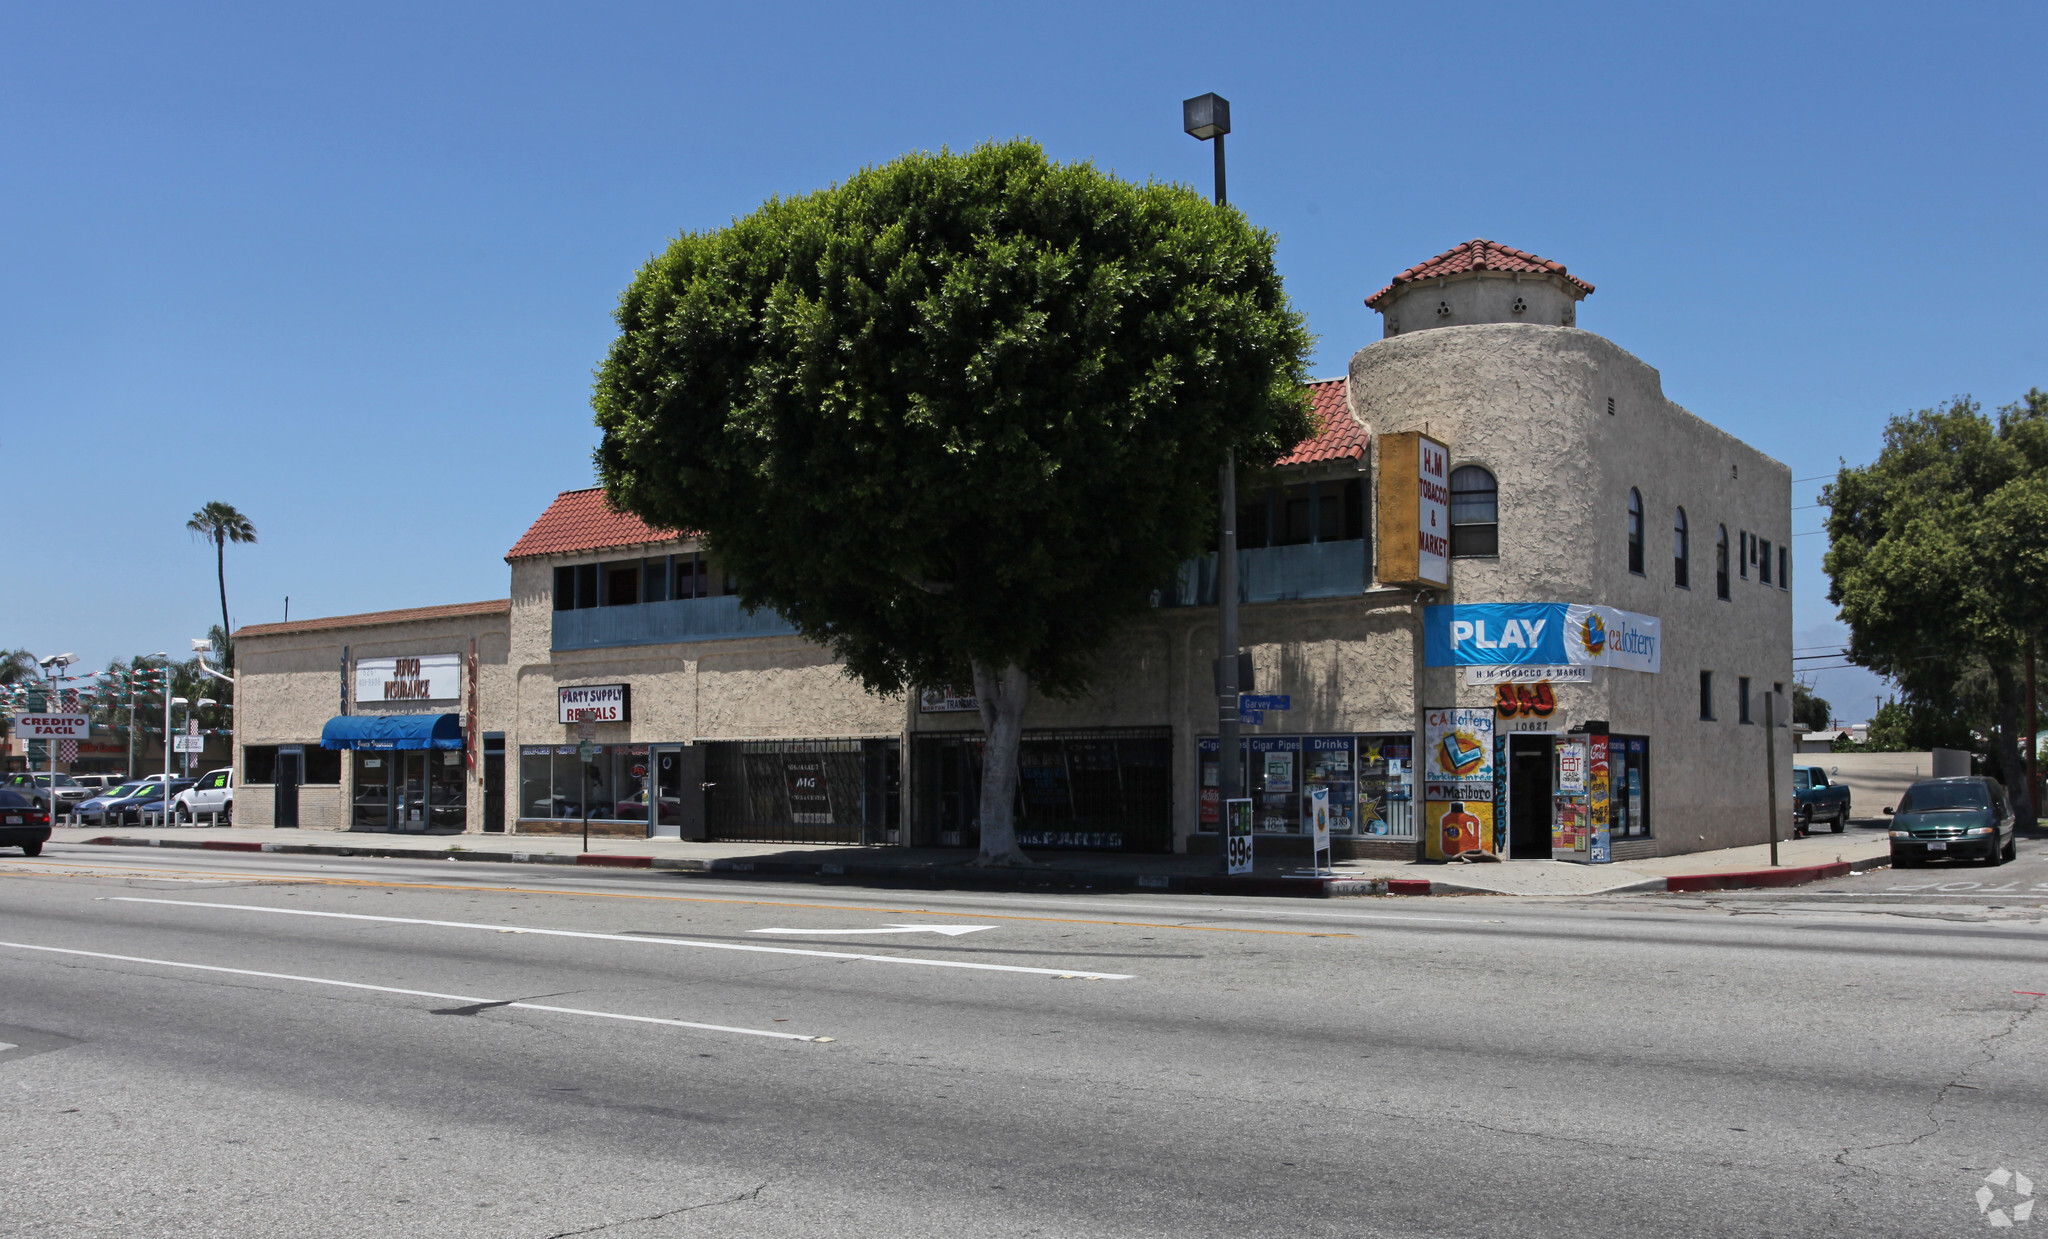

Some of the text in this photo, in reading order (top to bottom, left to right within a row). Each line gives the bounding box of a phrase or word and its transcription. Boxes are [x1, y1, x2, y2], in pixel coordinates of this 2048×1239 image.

[1424, 448, 1442, 478] H.M
[1420, 478, 1447, 506] TOBACCO
[1430, 509, 1436, 527] &
[1420, 531, 1447, 558] MARKET
[1450, 619, 1546, 650] PLAY
[394, 659, 420, 678] JUNCO
[1500, 670, 1541, 679] TOBACCO
[1546, 669, 1552, 677] &
[1556, 668, 1586, 677] MARKET
[384, 680, 430, 699] INSURANCE
[562, 689, 622, 703] PARTY SUPPLY
[1245, 699, 1270, 709] Garvey
[567, 707, 616, 721] REALS
[1430, 710, 1491, 731] CA Lottery
[21, 718, 85, 726] CREDITO
[1515, 722, 1548, 731] 10627
[1252, 740, 1299, 752] Cigar Pipes
[1315, 740, 1349, 749] Drinks
[1268, 762, 1291, 775] EBT
[1392, 762, 1397, 770] A
[1562, 758, 1581, 771] EBT
[1831, 766, 1839, 776] 2
[796, 778, 815, 788] MG
[1443, 785, 1491, 799] Marlboro
